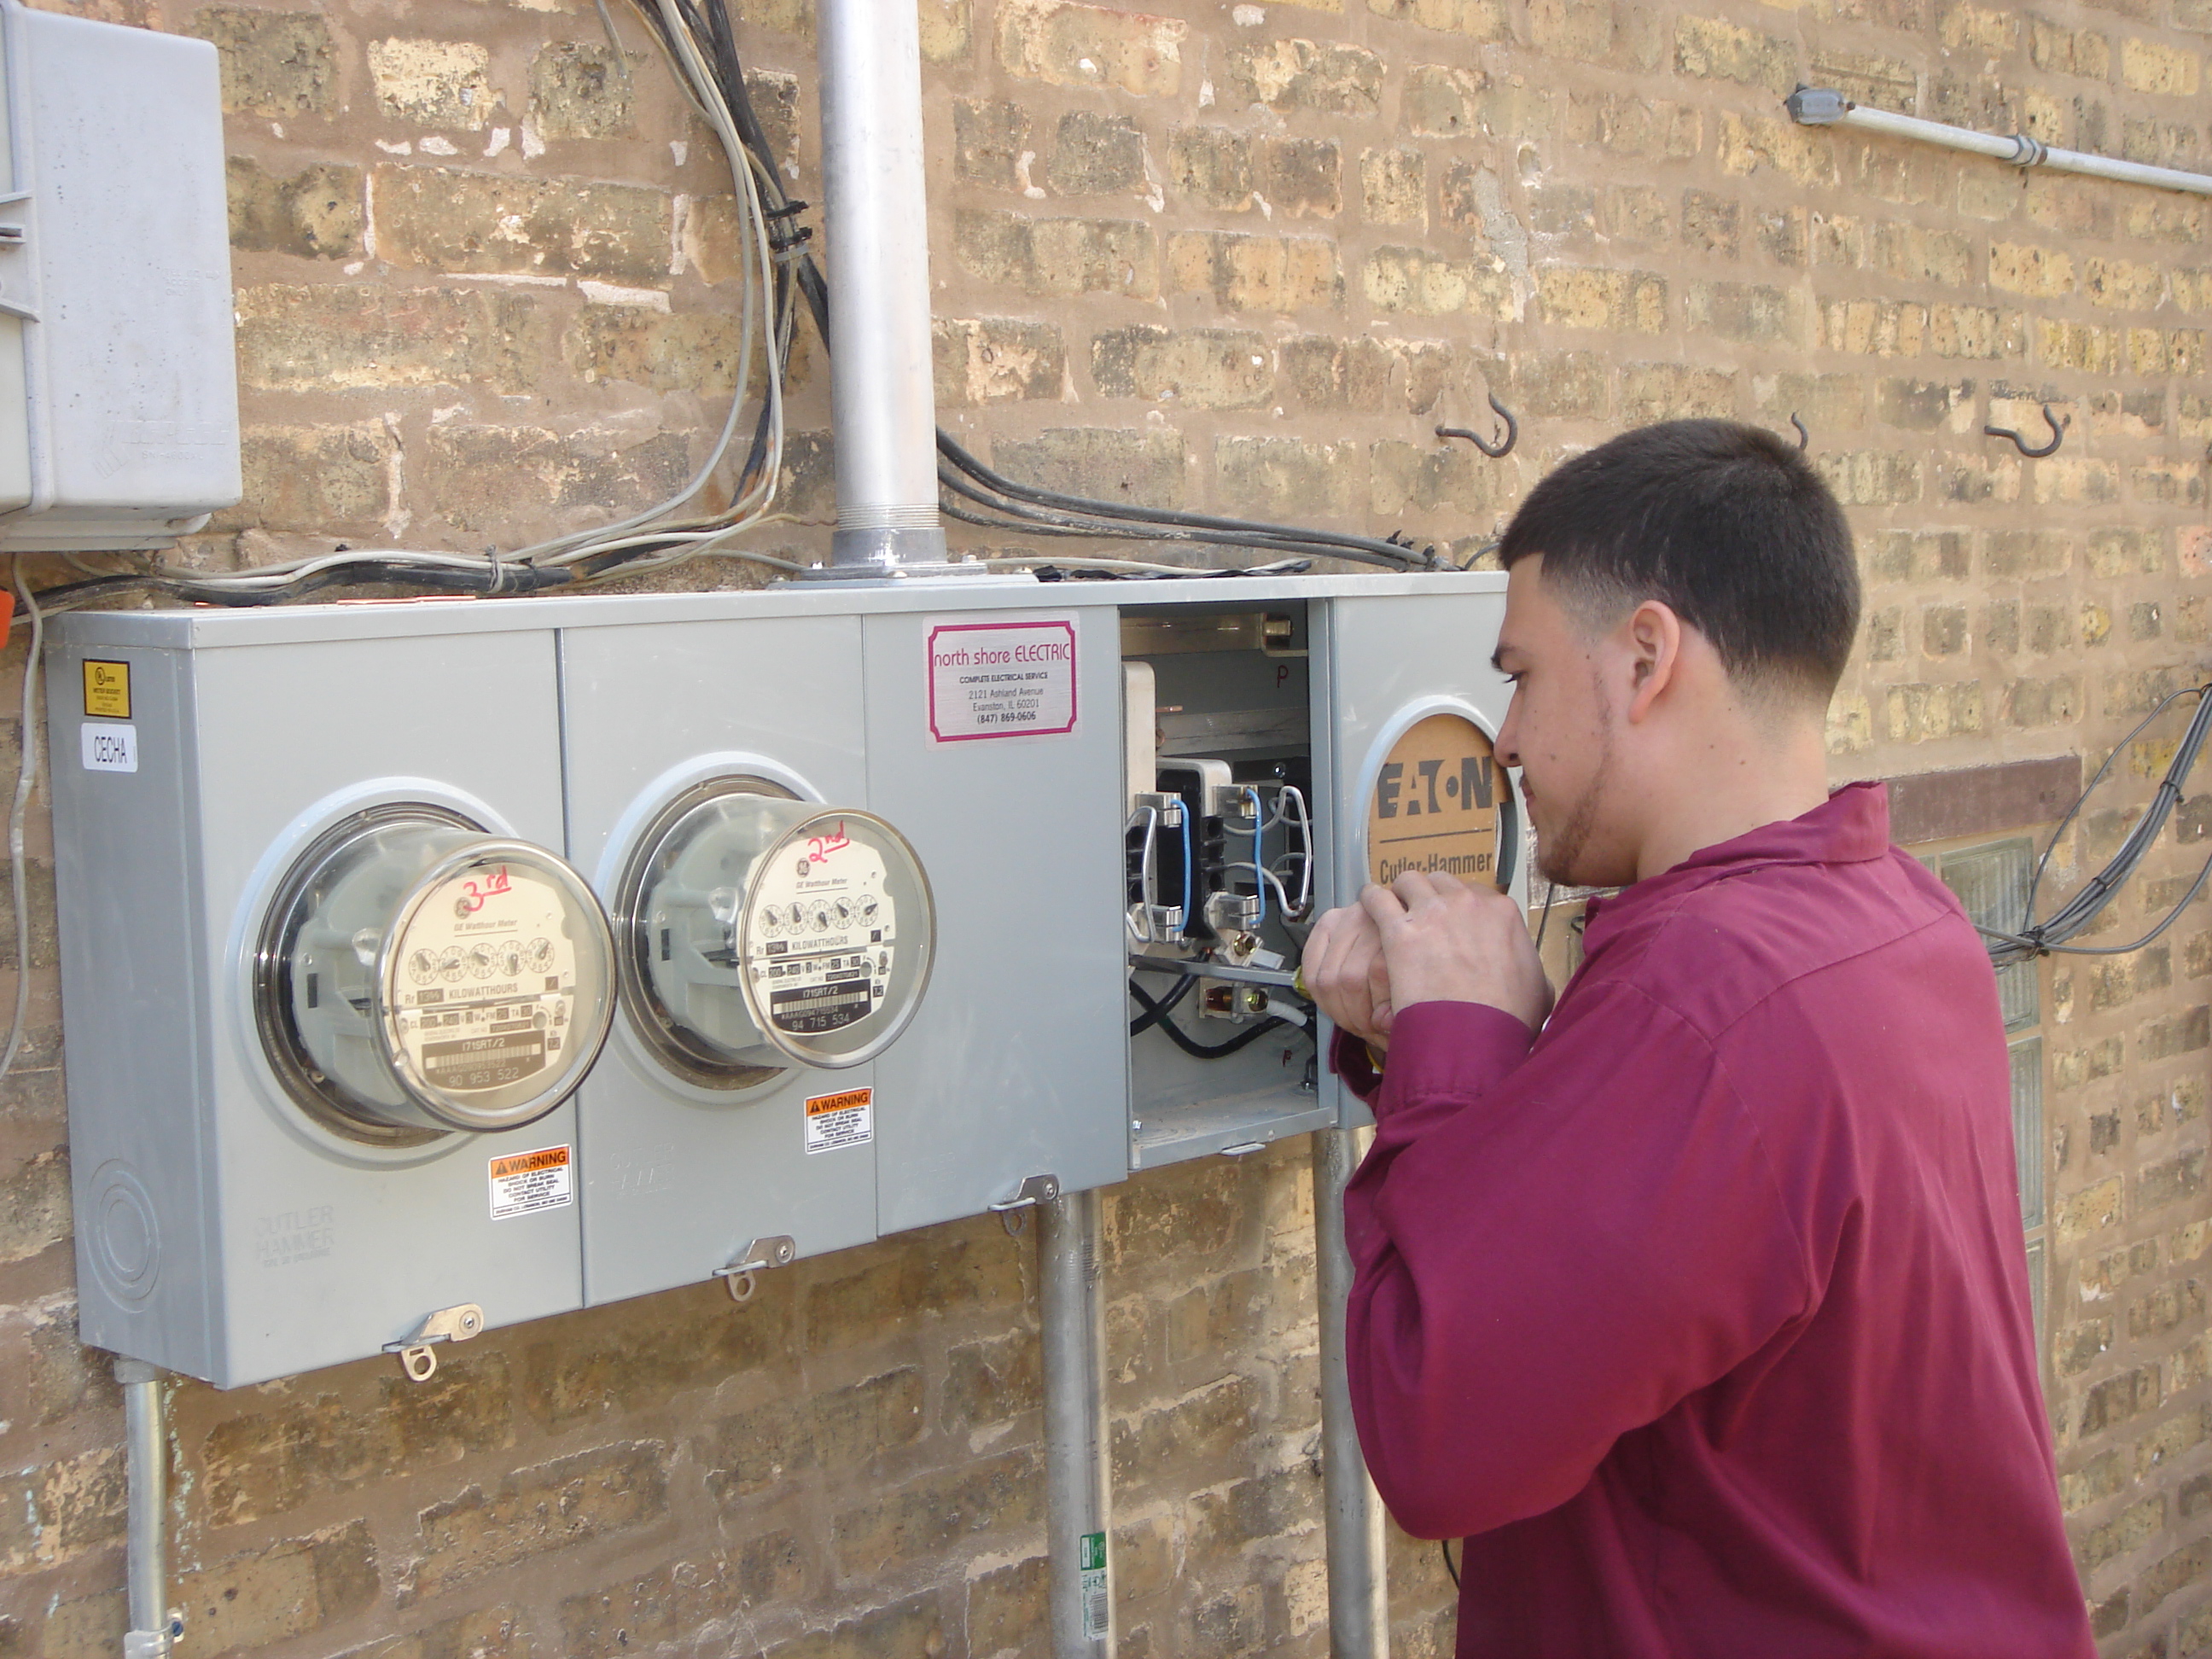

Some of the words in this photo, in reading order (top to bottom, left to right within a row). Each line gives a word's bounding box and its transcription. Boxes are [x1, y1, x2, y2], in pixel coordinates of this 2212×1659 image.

[934, 648, 969, 667] north
[974, 646, 1010, 665] shore
[1015, 643, 1070, 663] ELECTRIC
[959, 674, 990, 684] COMPLETE
[991, 672, 1024, 682] ELECTRICAL
[969, 690, 987, 700] 2121
[990, 687, 1016, 698] Ashland
[1018, 687, 1044, 696] Avenue
[973, 701, 1006, 712] Evanston,
[1008, 700, 1015, 710] IL
[1016, 699, 1039, 709] 60201
[977, 713, 998, 725] (847)
[1000, 711, 1037, 722] 869-0606
[94, 735, 127, 764] CECHA
[1377, 756, 1493, 819] EATON
[807, 819, 851, 864] 2nd
[463, 864, 512, 912] 3rd
[498, 919, 518, 928] Meter
[791, 935, 848, 951] KILOWATTHOURS
[448, 982, 519, 1000] KILOWATTHOURS
[792, 1020, 804, 1031] 94
[810, 1016, 827, 1028] 715
[832, 1012, 851, 1025] 534
[448, 1074, 463, 1087] 90
[469, 1071, 491, 1085] 953
[498, 1067, 519, 1080] 522
[820, 1091, 868, 1111] WARNING
[509, 1150, 567, 1173] WARNING
[531, 1167, 564, 1178] ELECTRICAL
[508, 1179, 528, 1187] SHOCK
[509, 1189, 534, 1199] CONTACT
[535, 1184, 556, 1193] UTILITY
[527, 1181, 544, 1190] BREAK
